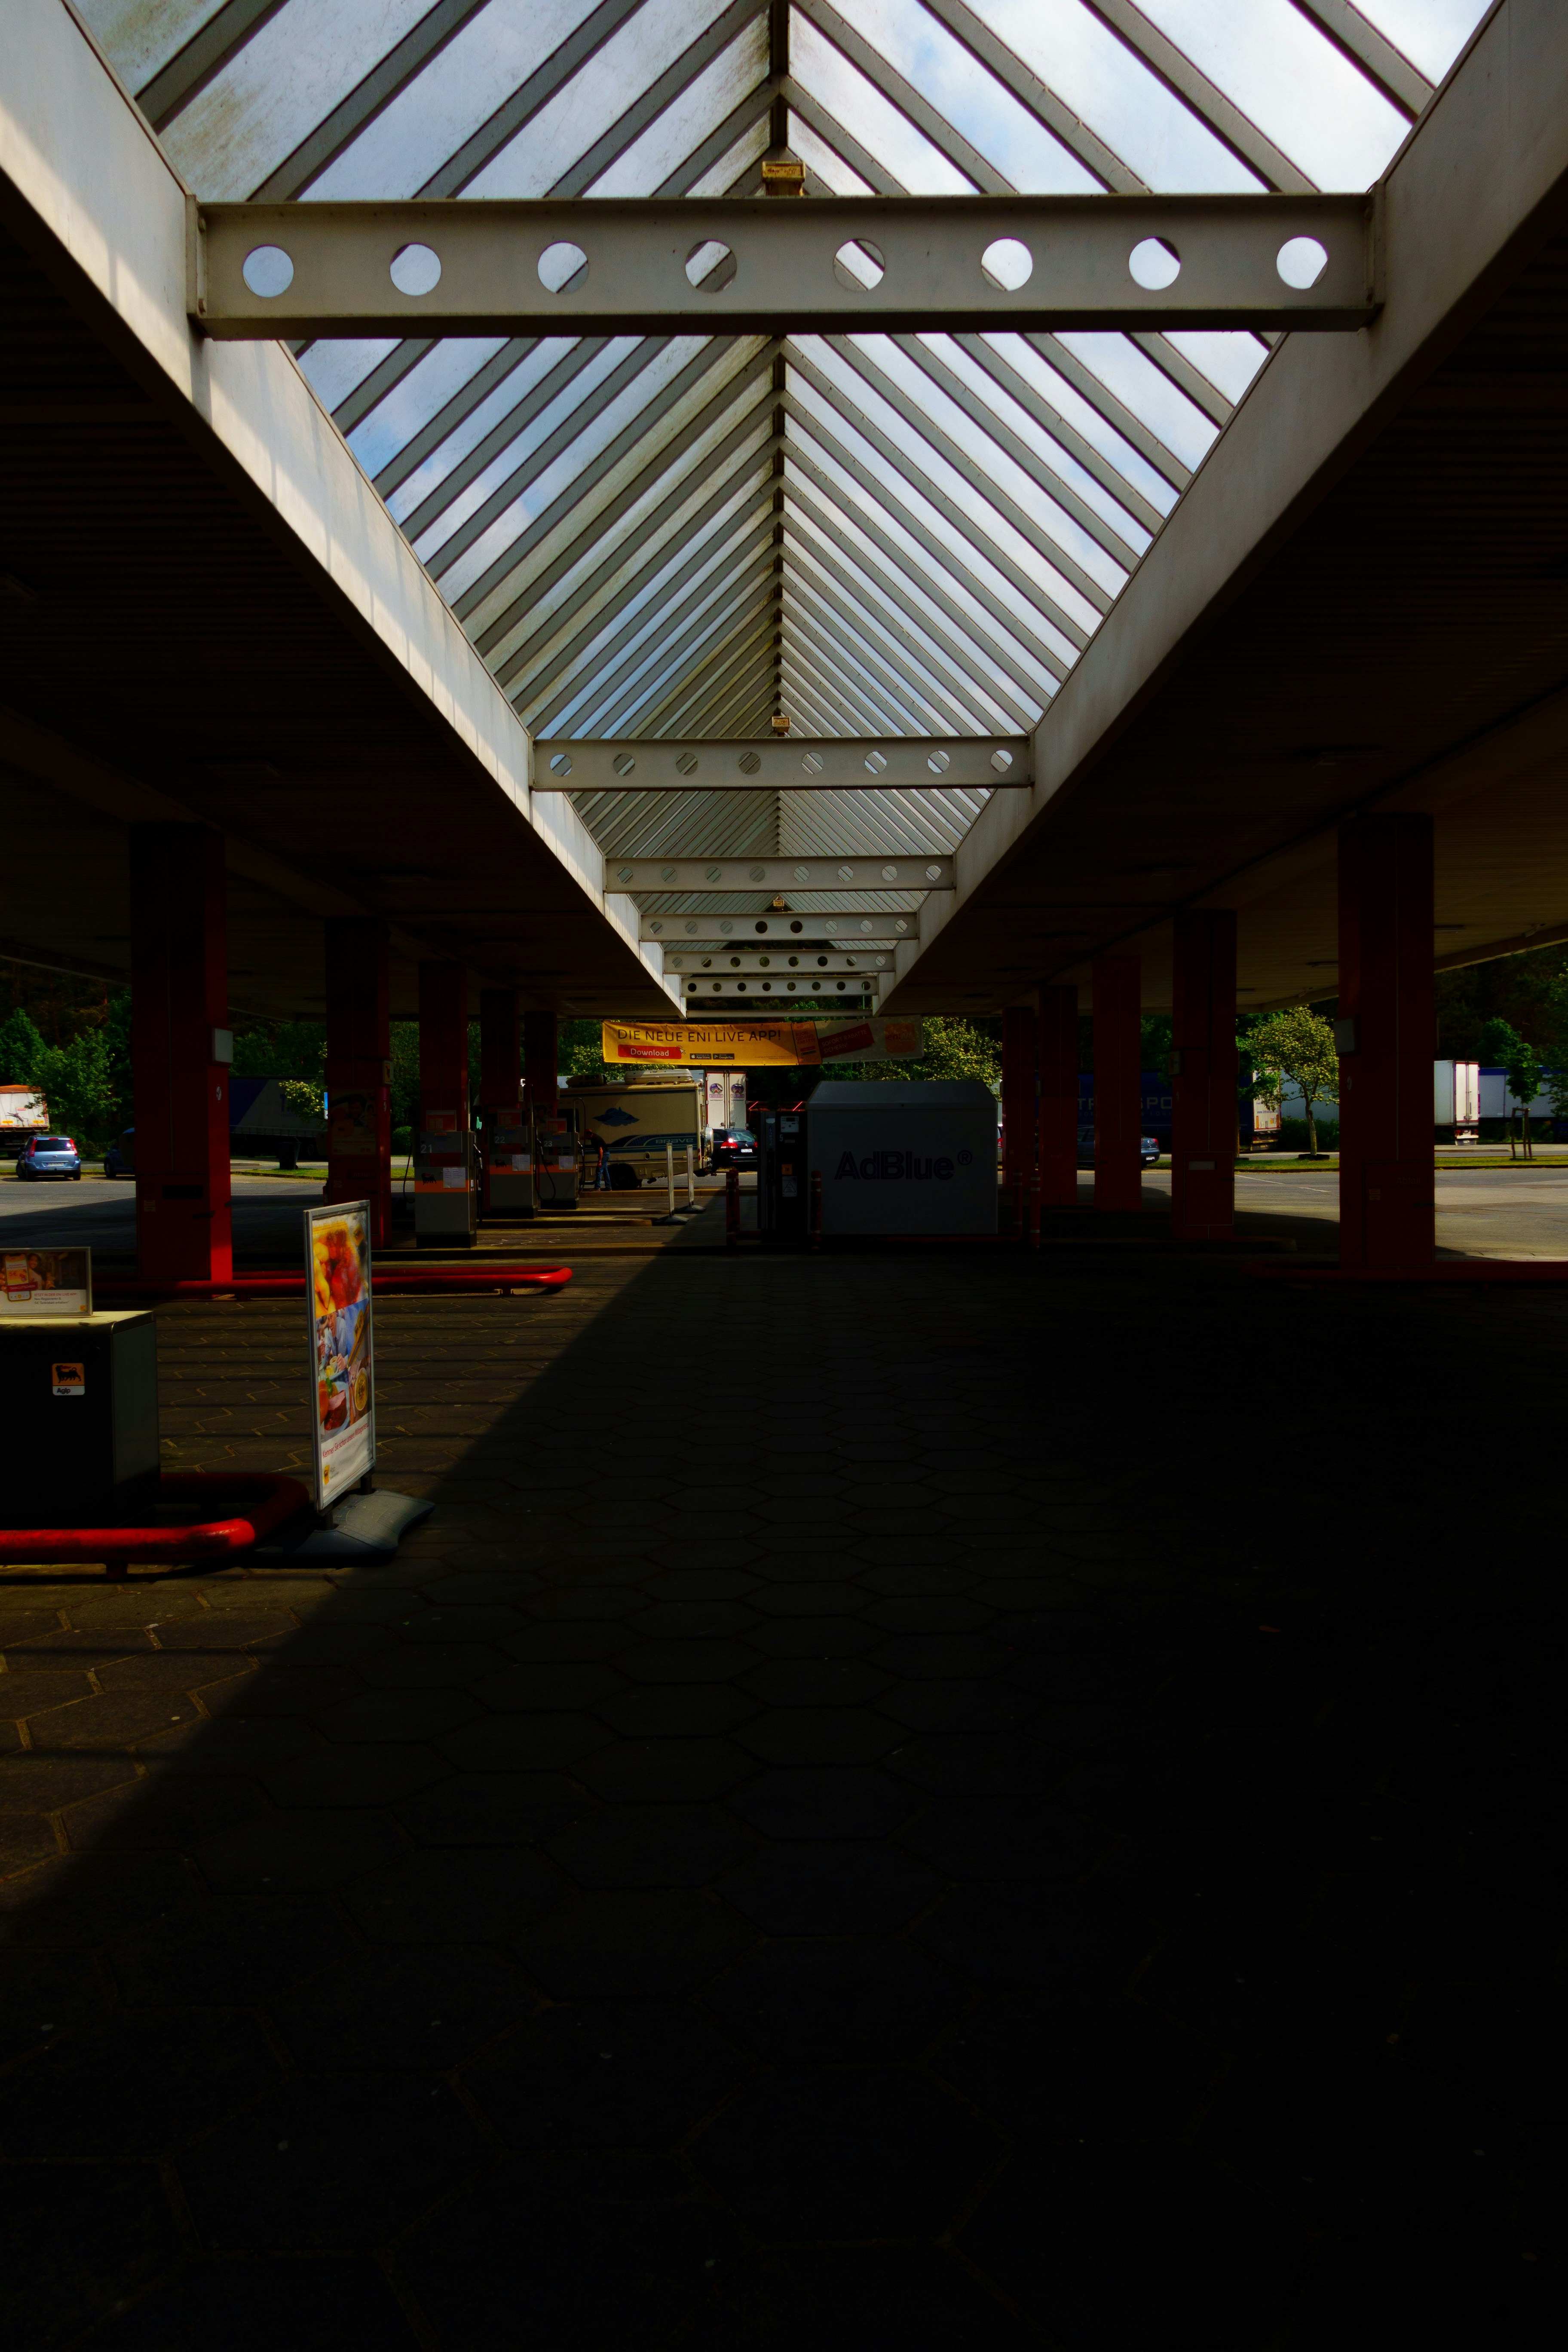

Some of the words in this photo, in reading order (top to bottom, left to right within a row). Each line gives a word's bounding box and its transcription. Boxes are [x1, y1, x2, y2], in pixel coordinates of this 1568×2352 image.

[618, 1029, 640, 1040] DIE
[646, 1031, 683, 1041] NEUE
[688, 1032, 710, 1042] ENI
[715, 1032, 744, 1042] LIVE
[749, 1030, 781, 1041] APP!
[821, 1038, 842, 1047] SOFORT
[843, 1029, 867, 1040] RABATTE
[630, 1048, 669, 1057] Download
[824, 1042, 848, 1054] SICHERN!
[420, 1144, 432, 1153] 21
[1396, 1176, 1421, 1185] Abfall
[322, 1447, 334, 1458] Kennen
